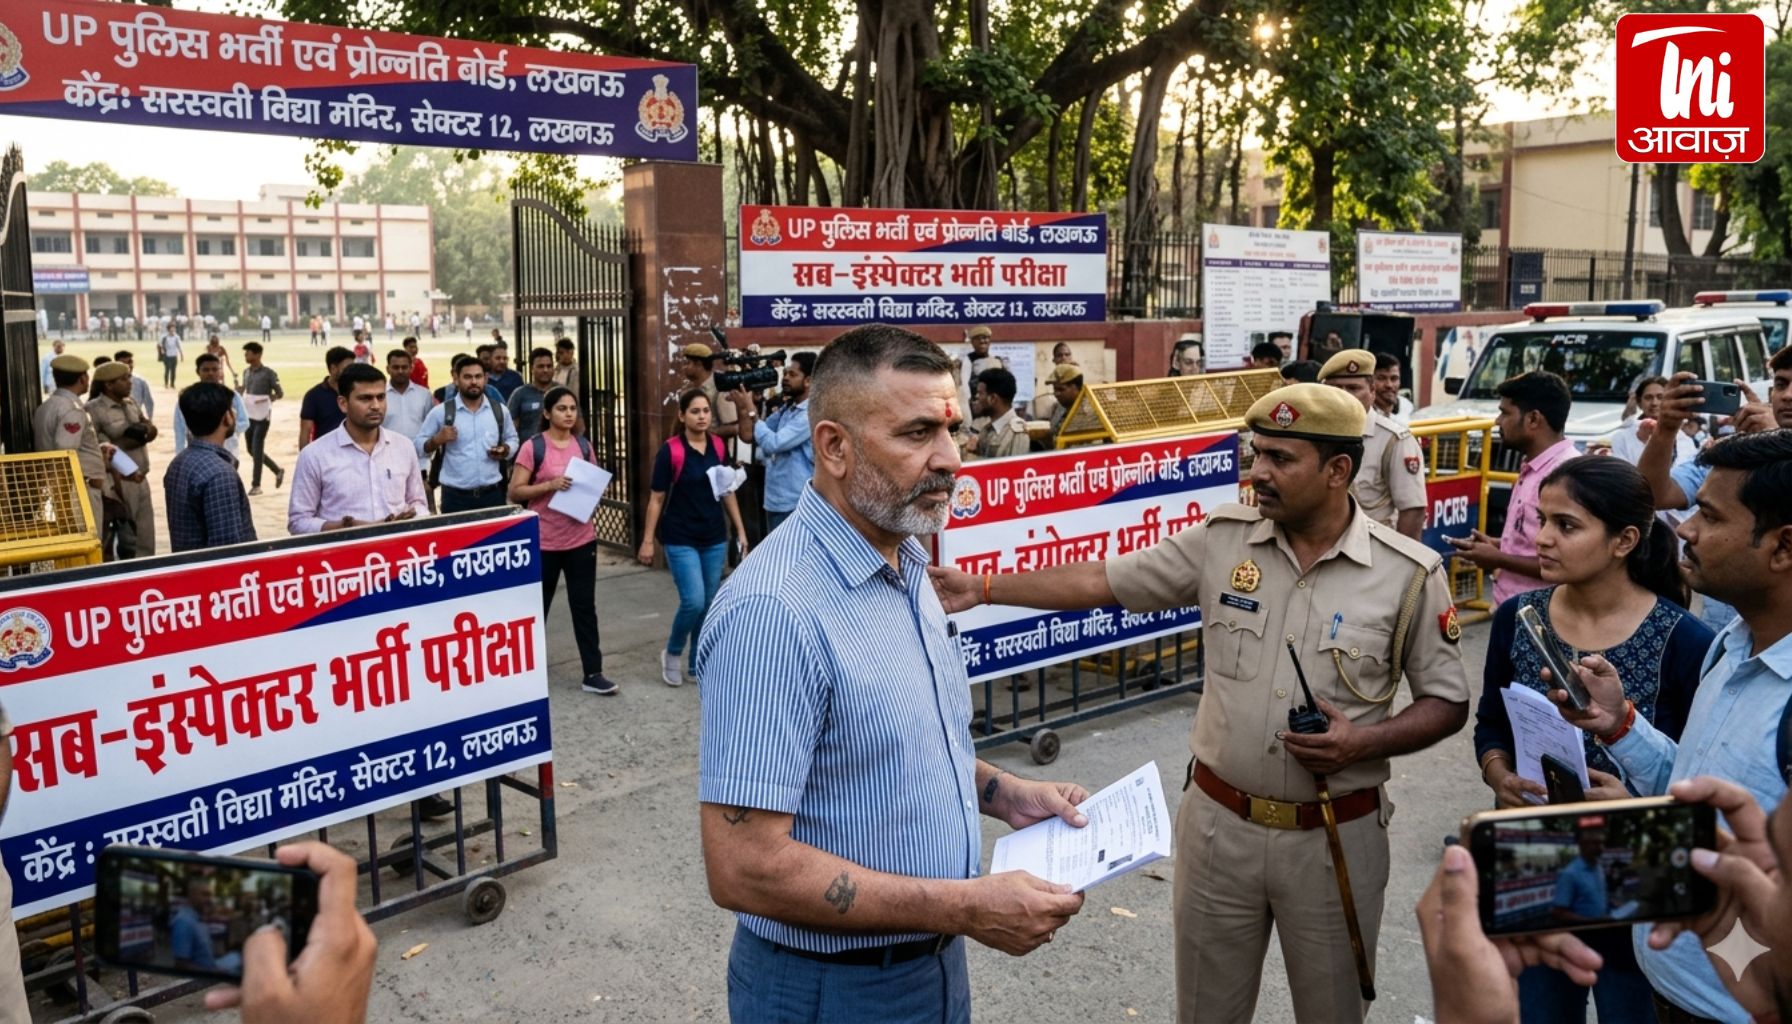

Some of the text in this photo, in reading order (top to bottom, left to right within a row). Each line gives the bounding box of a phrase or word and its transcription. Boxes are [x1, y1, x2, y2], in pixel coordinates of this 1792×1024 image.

[42, 11, 626, 98] UP पुलिस भर्ती एवं प्रोन्नति बोर्ड, लखनऊ
[139, 82, 252, 120] सरस्वती
[261, 85, 321, 124] विद्या
[329, 94, 402, 134] मंदिर,
[410, 99, 483, 137] सेक्टर
[489, 115, 520, 142] 12,
[528, 117, 615, 145] लखनऊ
[788, 217, 816, 239] UP
[820, 213, 872, 249] पुलिस
[875, 214, 910, 241] भर्ती
[913, 217, 939, 242] एवं
[1002, 217, 1035, 245] बोर्ड,
[793, 255, 1067, 290] सब-इंस्पेक्टर भर्ती परीक्षा
[986, 477, 1010, 507] UP
[1013, 467, 1055, 514] पुलिस
[1059, 460, 1086, 495] भर्ती
[64, 606, 111, 648] UP
[119, 588, 202, 655] पुलिस
[209, 570, 261, 622] भर्ती
[266, 566, 305, 614] एवं
[309, 551, 391, 608] प्रोन्नति
[396, 542, 445, 588] बोर्ड,
[450, 538, 532, 580] लखनऊ
[11, 611, 536, 793] सब-इंस्पेक्टर भर्ती परीक्षा
[214, 788, 273, 830] विद्या
[279, 766, 345, 809] मंदिर,
[350, 752, 416, 791] सेक्टर
[423, 741, 456, 771] 12,
[461, 716, 538, 760] लखनऊ
